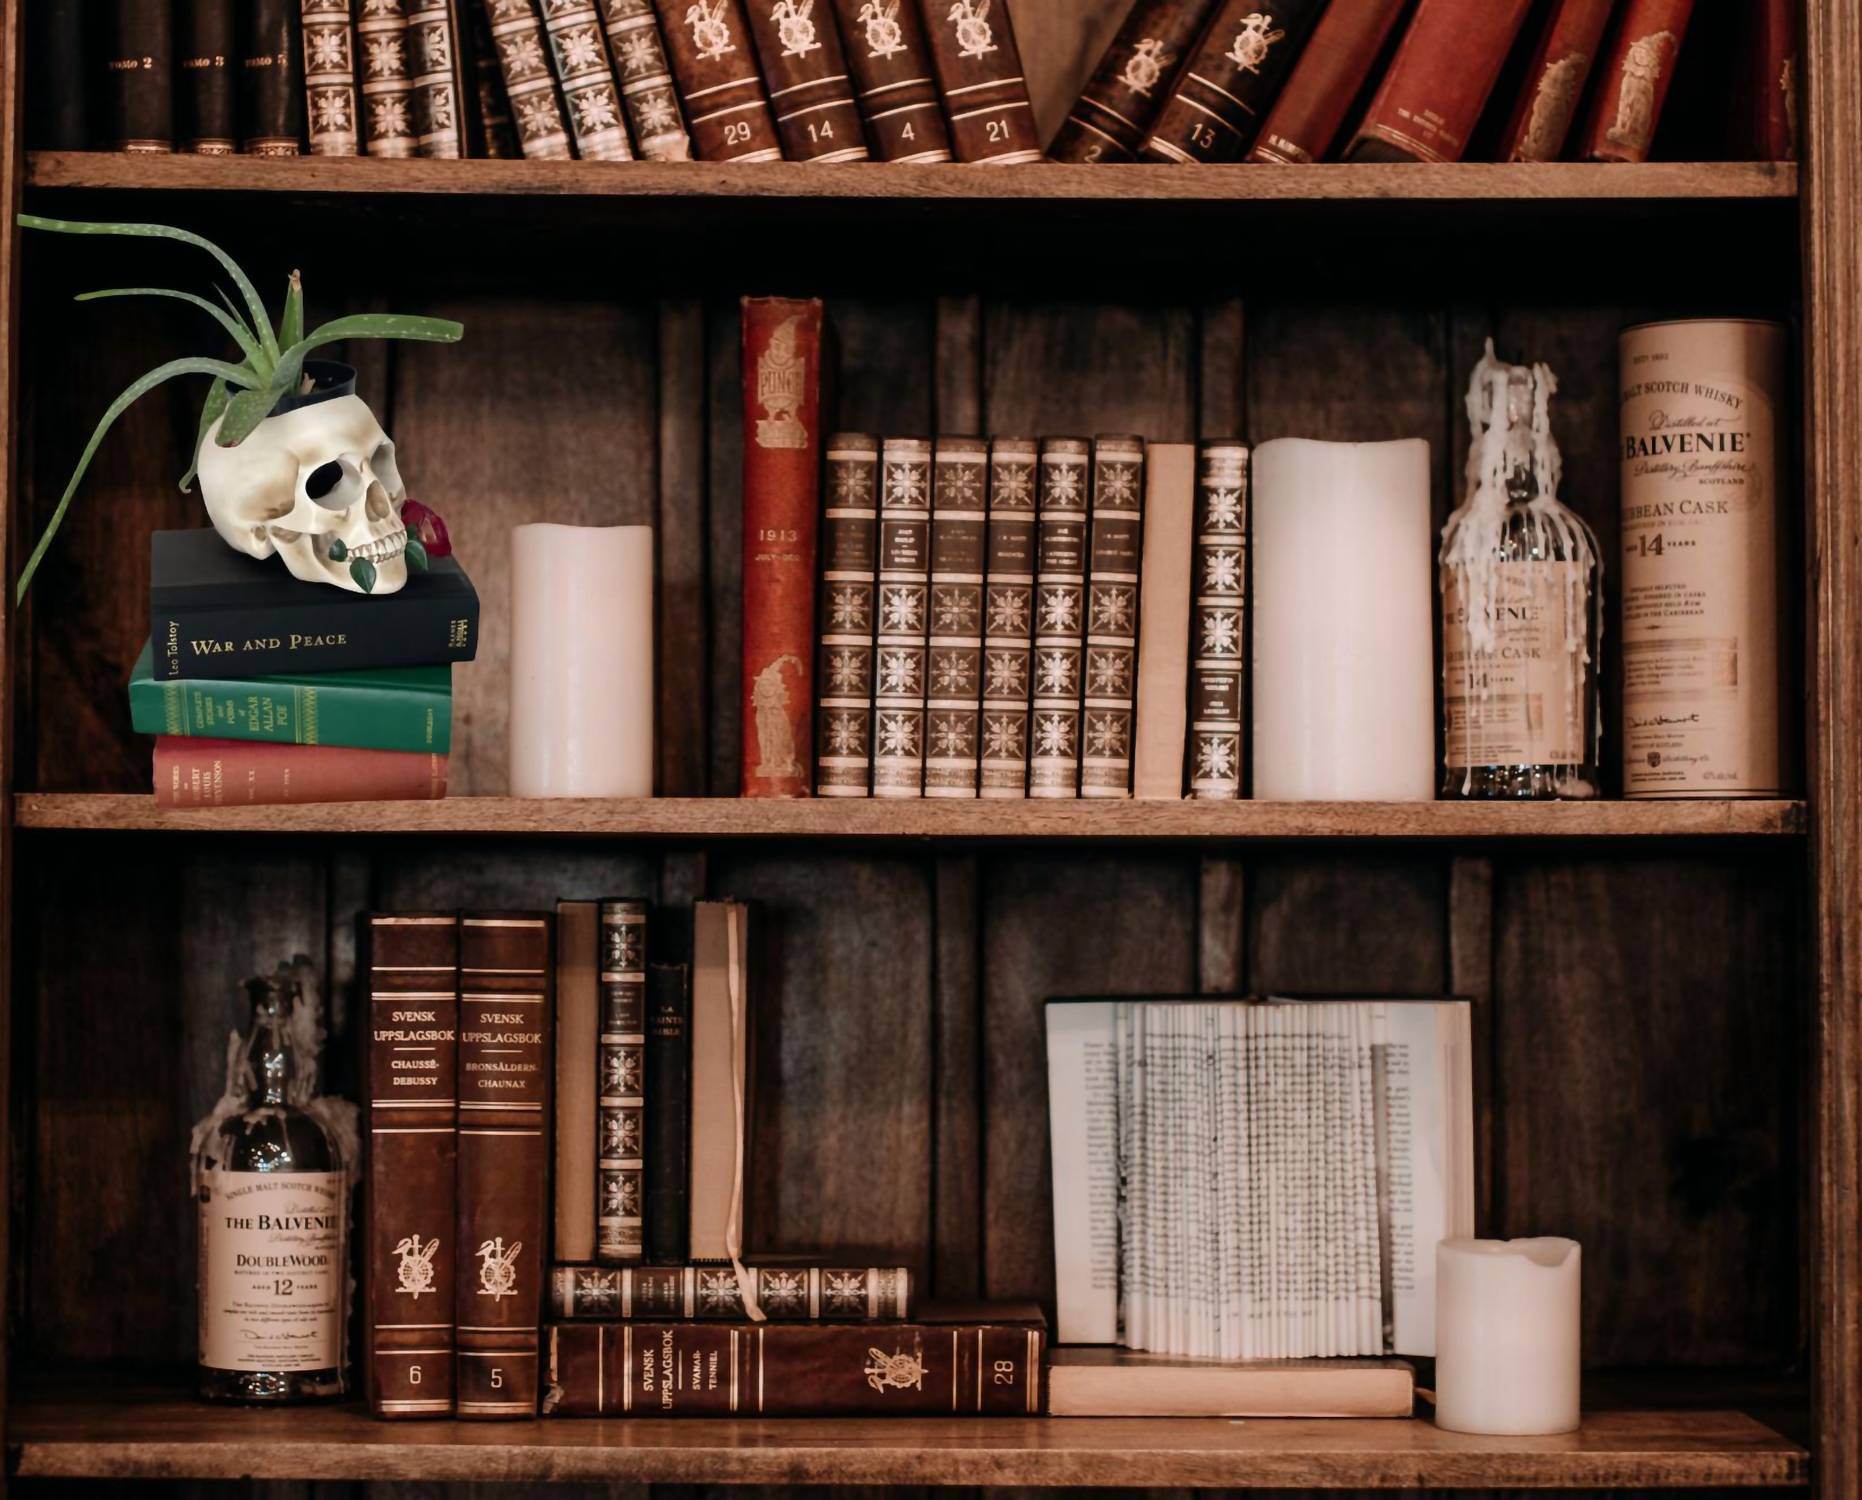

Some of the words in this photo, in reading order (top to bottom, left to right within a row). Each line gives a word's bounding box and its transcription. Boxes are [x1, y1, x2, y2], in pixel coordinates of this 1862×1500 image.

[142, 56, 153, 69] 2
[215, 55, 225, 68] 3
[277, 54, 288, 66] 5
[723, 120, 751, 146] 29
[806, 120, 834, 144] 14
[900, 121, 916, 142] 4
[984, 119, 1010, 143] 21
[1190, 122, 1217, 149] 13
[1645, 381, 1689, 395] SCOTCH
[1694, 384, 1744, 411] WHISKY
[1626, 431, 1744, 460] BALVENIE
[1699, 477, 1745, 486] SCOTLAND
[1679, 500, 1729, 515] CASK
[760, 528, 798, 542] 1913
[1639, 533, 1664, 557] 14
[1667, 540, 1696, 548] YEARS
[166, 620, 180, 657] Tolstoy
[191, 640, 235, 656] WAR
[243, 638, 281, 651] AND
[289, 634, 347, 650] PEACE
[168, 658, 179, 676] Leo
[248, 696, 260, 732] EDGAR
[262, 697, 274, 732] ALLAN
[276, 704, 288, 726] POE
[392, 1011, 436, 1022] SVENSK
[480, 1013, 525, 1025] SVENSK
[373, 1030, 455, 1042] UPPSLAGSBOK
[462, 1032, 543, 1044] UPPSLAGSBOK
[393, 1077, 439, 1086] DEBUSSY
[477, 1079, 527, 1089] CHAUNAX
[256, 1182, 279, 1193] MALT
[281, 1182, 312, 1192] SCOTCH
[225, 1216, 254, 1230] THE
[273, 1278, 293, 1296] 12
[409, 1364, 422, 1385] 6
[490, 1367, 503, 1389] 5
[643, 1348, 655, 1392] SVENSK
[661, 1329, 674, 1410] UPPSLAGSBOK
[708, 1349, 718, 1391] TENNIEL
[993, 1360, 1014, 1385] 28
